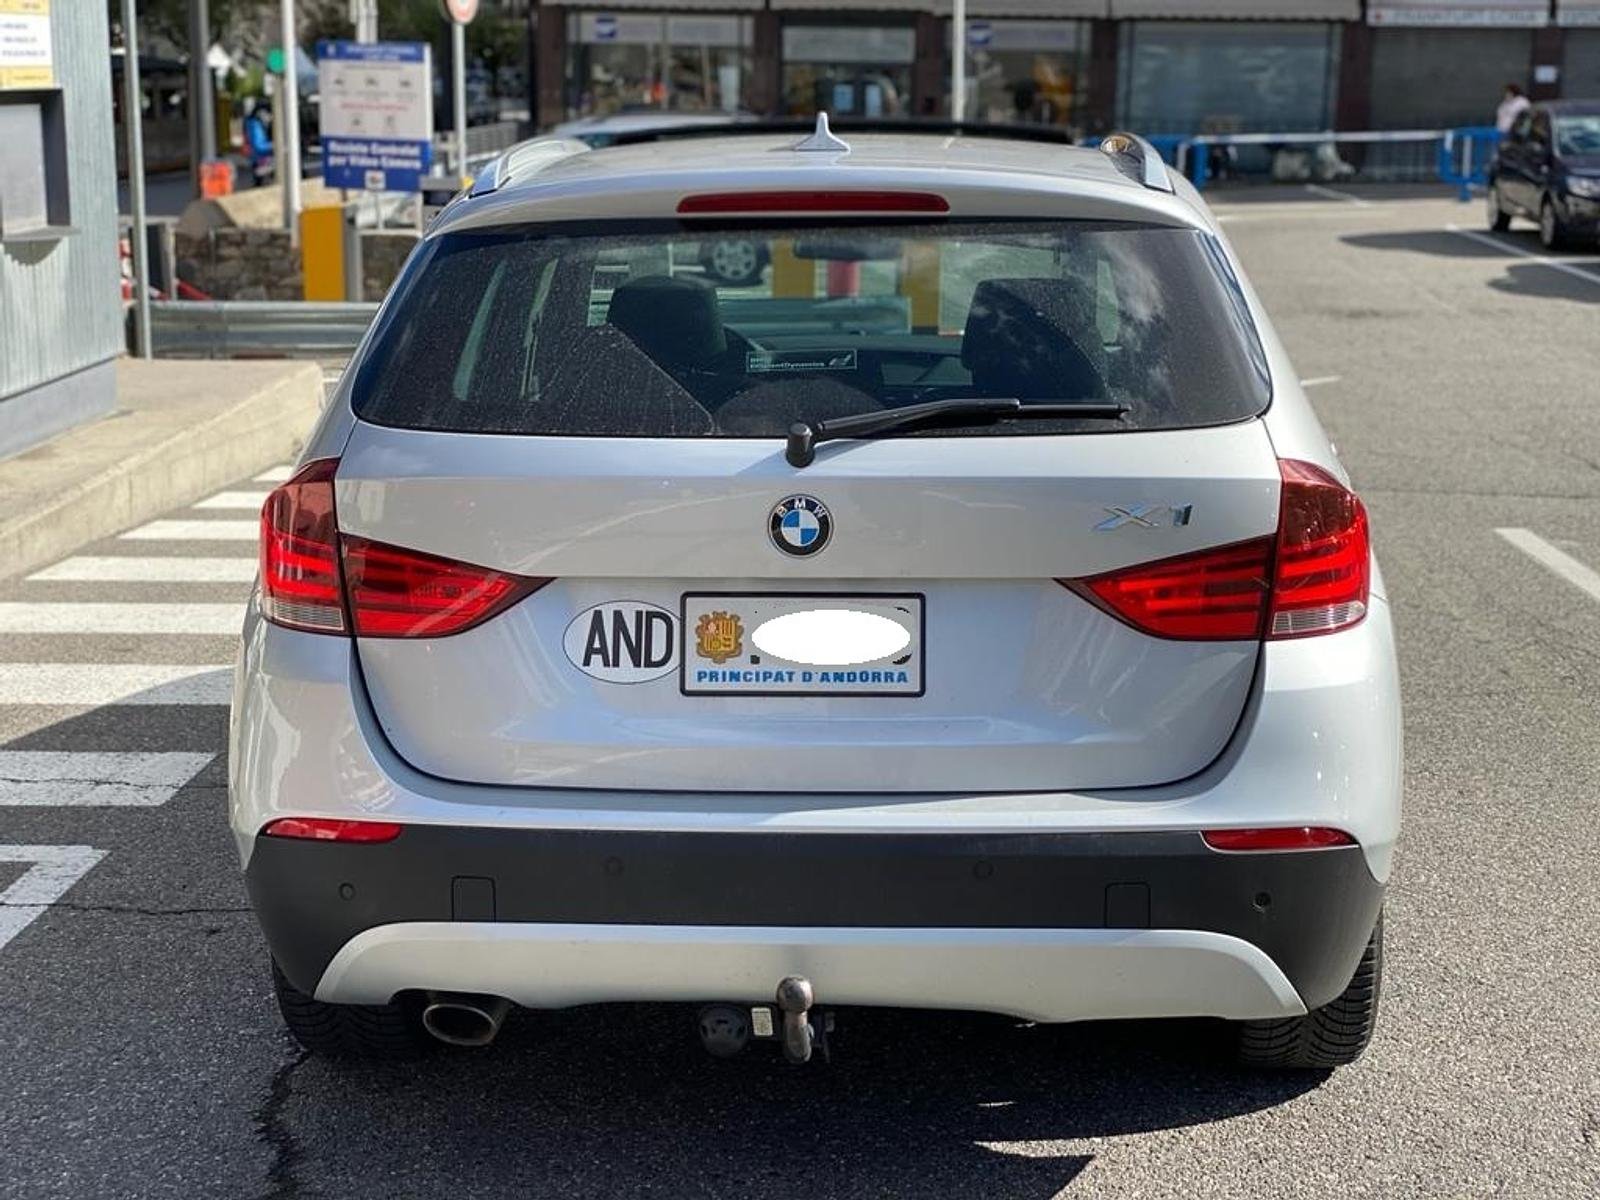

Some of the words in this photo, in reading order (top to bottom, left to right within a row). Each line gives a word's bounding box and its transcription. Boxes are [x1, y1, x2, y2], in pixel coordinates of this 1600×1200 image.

[776, 496, 827, 518] BMW
[1093, 502, 1194, 532] X1
[582, 609, 674, 668] AND
[696, 670, 796, 684] PRINCIPAT
[801, 669, 909, 684] D'ANDORRA
